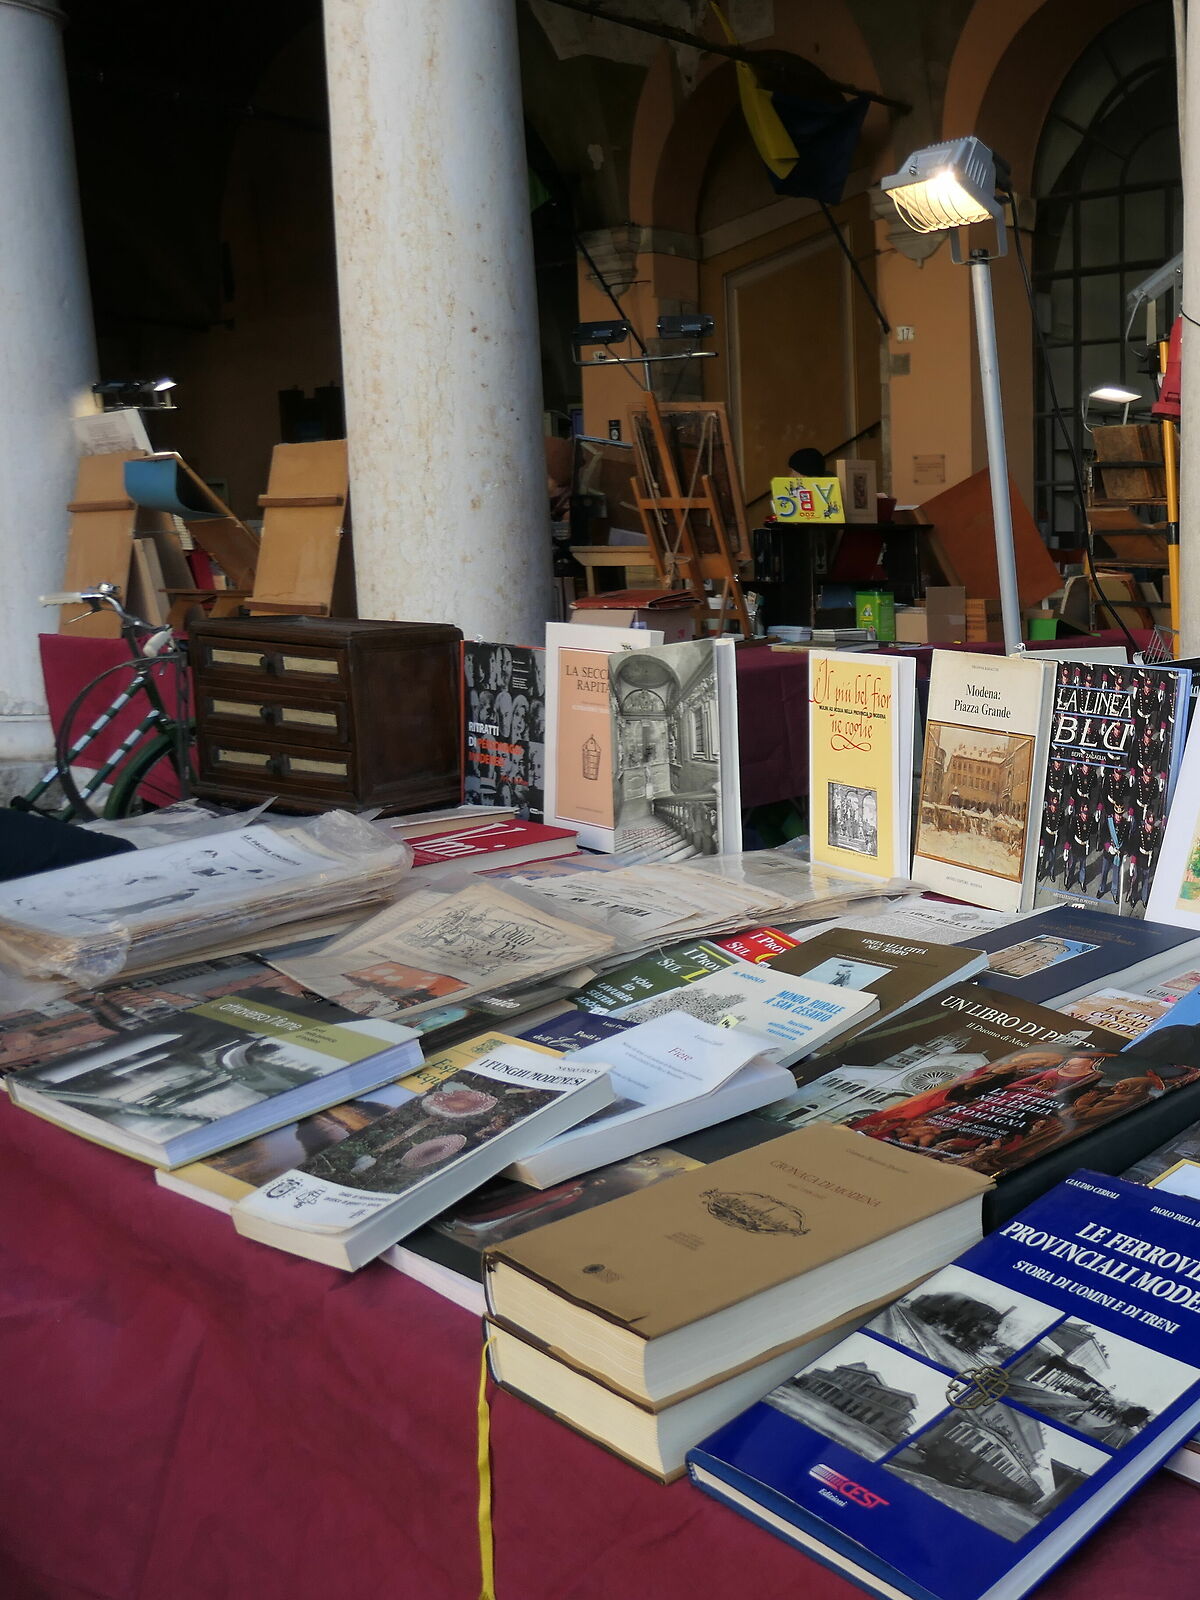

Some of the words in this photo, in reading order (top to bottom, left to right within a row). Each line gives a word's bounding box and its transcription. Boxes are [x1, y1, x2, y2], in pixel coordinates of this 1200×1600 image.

[565, 664, 579, 677] LA
[855, 674, 871, 706] bel
[871, 677, 892, 715] fior
[965, 683, 1001, 701] Modena:
[1056, 688, 1078, 712] LA
[1083, 691, 1132, 718] LINEA
[953, 699, 979, 716] Piazza
[981, 703, 1012, 720] Grande
[468, 721, 500, 737] RITRATTI
[1053, 716, 1135, 751] BLU
[468, 735, 477, 747] DI
[725, 940, 750, 957] SUL
[881, 946, 909, 957] TEMPO
[656, 957, 683, 974] SUL
[762, 997, 777, 1005] A
[771, 1000, 796, 1011] SAN
[791, 1005, 834, 1023] CESARIO
[775, 990, 812, 1005] MONDO
[807, 999, 847, 1015] RURALE
[1104, 1006, 1124, 1015] LA
[940, 994, 970, 1016] UN
[964, 1001, 1020, 1031] LIBRO
[1014, 1021, 1046, 1036] DI
[973, 1023, 1003, 1041] Duomo
[486, 1060, 529, 1079] FUNGHI
[527, 1069, 588, 1087] MODENESI
[989, 1087, 1008, 1097] LA
[1010, 1092, 1066, 1109] PITTURA
[949, 1104, 1027, 1128] ROMAGNA
[986, 1104, 1026, 1119] NELLA
[769, 1160, 820, 1185] CRONACA
[830, 1184, 881, 1208] MODENA
[1065, 1177, 1095, 1193] CLAUDIO
[1093, 1184, 1121, 1200] CERIOLI
[1150, 1205, 1174, 1219] PAOLO
[1173, 1211, 1197, 1225] DELLA
[1075, 1221, 1112, 1244] LE
[999, 1220, 1136, 1284] PROVINCIALI
[1012, 1259, 1054, 1284] STORIA
[1052, 1273, 1070, 1289] DI
[1068, 1279, 1115, 1308] UOMINI
[1113, 1298, 1125, 1311] E
[1126, 1303, 1144, 1320] DI
[1141, 1309, 1182, 1335] TRENI
[817, 1487, 848, 1508] Edizioni
[839, 1480, 890, 1510] CEST
